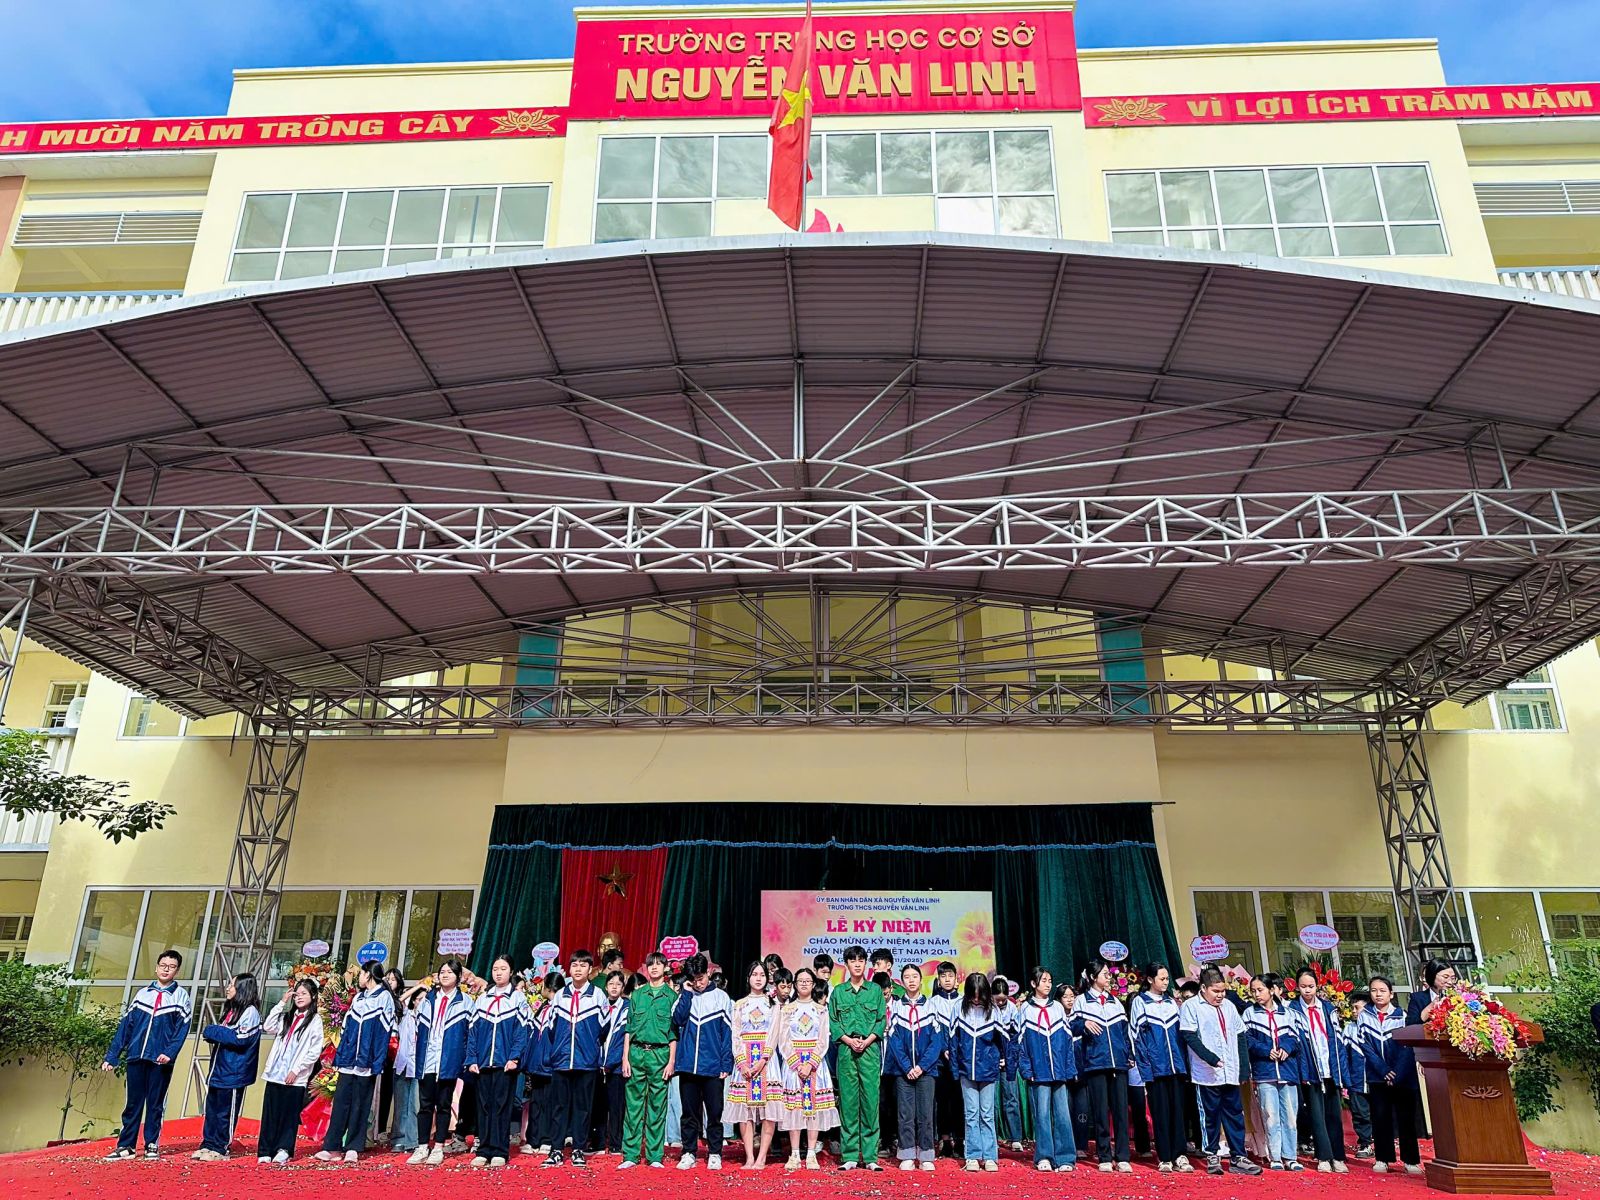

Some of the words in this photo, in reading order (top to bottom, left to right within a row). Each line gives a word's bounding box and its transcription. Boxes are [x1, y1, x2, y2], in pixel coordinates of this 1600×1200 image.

[617, 27, 747, 54] TRƯỜNG
[755, 30, 856, 52] TRNG
[865, 27, 929, 55] HỌC
[937, 26, 983, 49] CƠ
[991, 20, 1036, 48] SỞ
[818, 57, 913, 98] VĂN
[929, 60, 1036, 96] LINH
[1186, 96, 1222, 117] VÌ
[1235, 96, 1293, 119] LỢI
[1306, 93, 1371, 115] ÍCH
[1380, 90, 1490, 112] TRĂM
[1500, 87, 1593, 109] NĂM
[38, 124, 142, 147] MƯỜI
[151, 121, 244, 143] NĂM
[257, 115, 385, 139] TRỒNG
[399, 113, 474, 135] CÂY
[809, 936, 838, 945] CHÀO
[839, 936, 869, 945] MỪNG
[886, 936, 910, 946] NIỆM
[927, 936, 950, 945] NĂM
[826, 915, 848, 933] LỄ
[853, 916, 877, 933] KỶ
[882, 918, 931, 936] NIỆM
[803, 946, 832, 955] NGÀY
